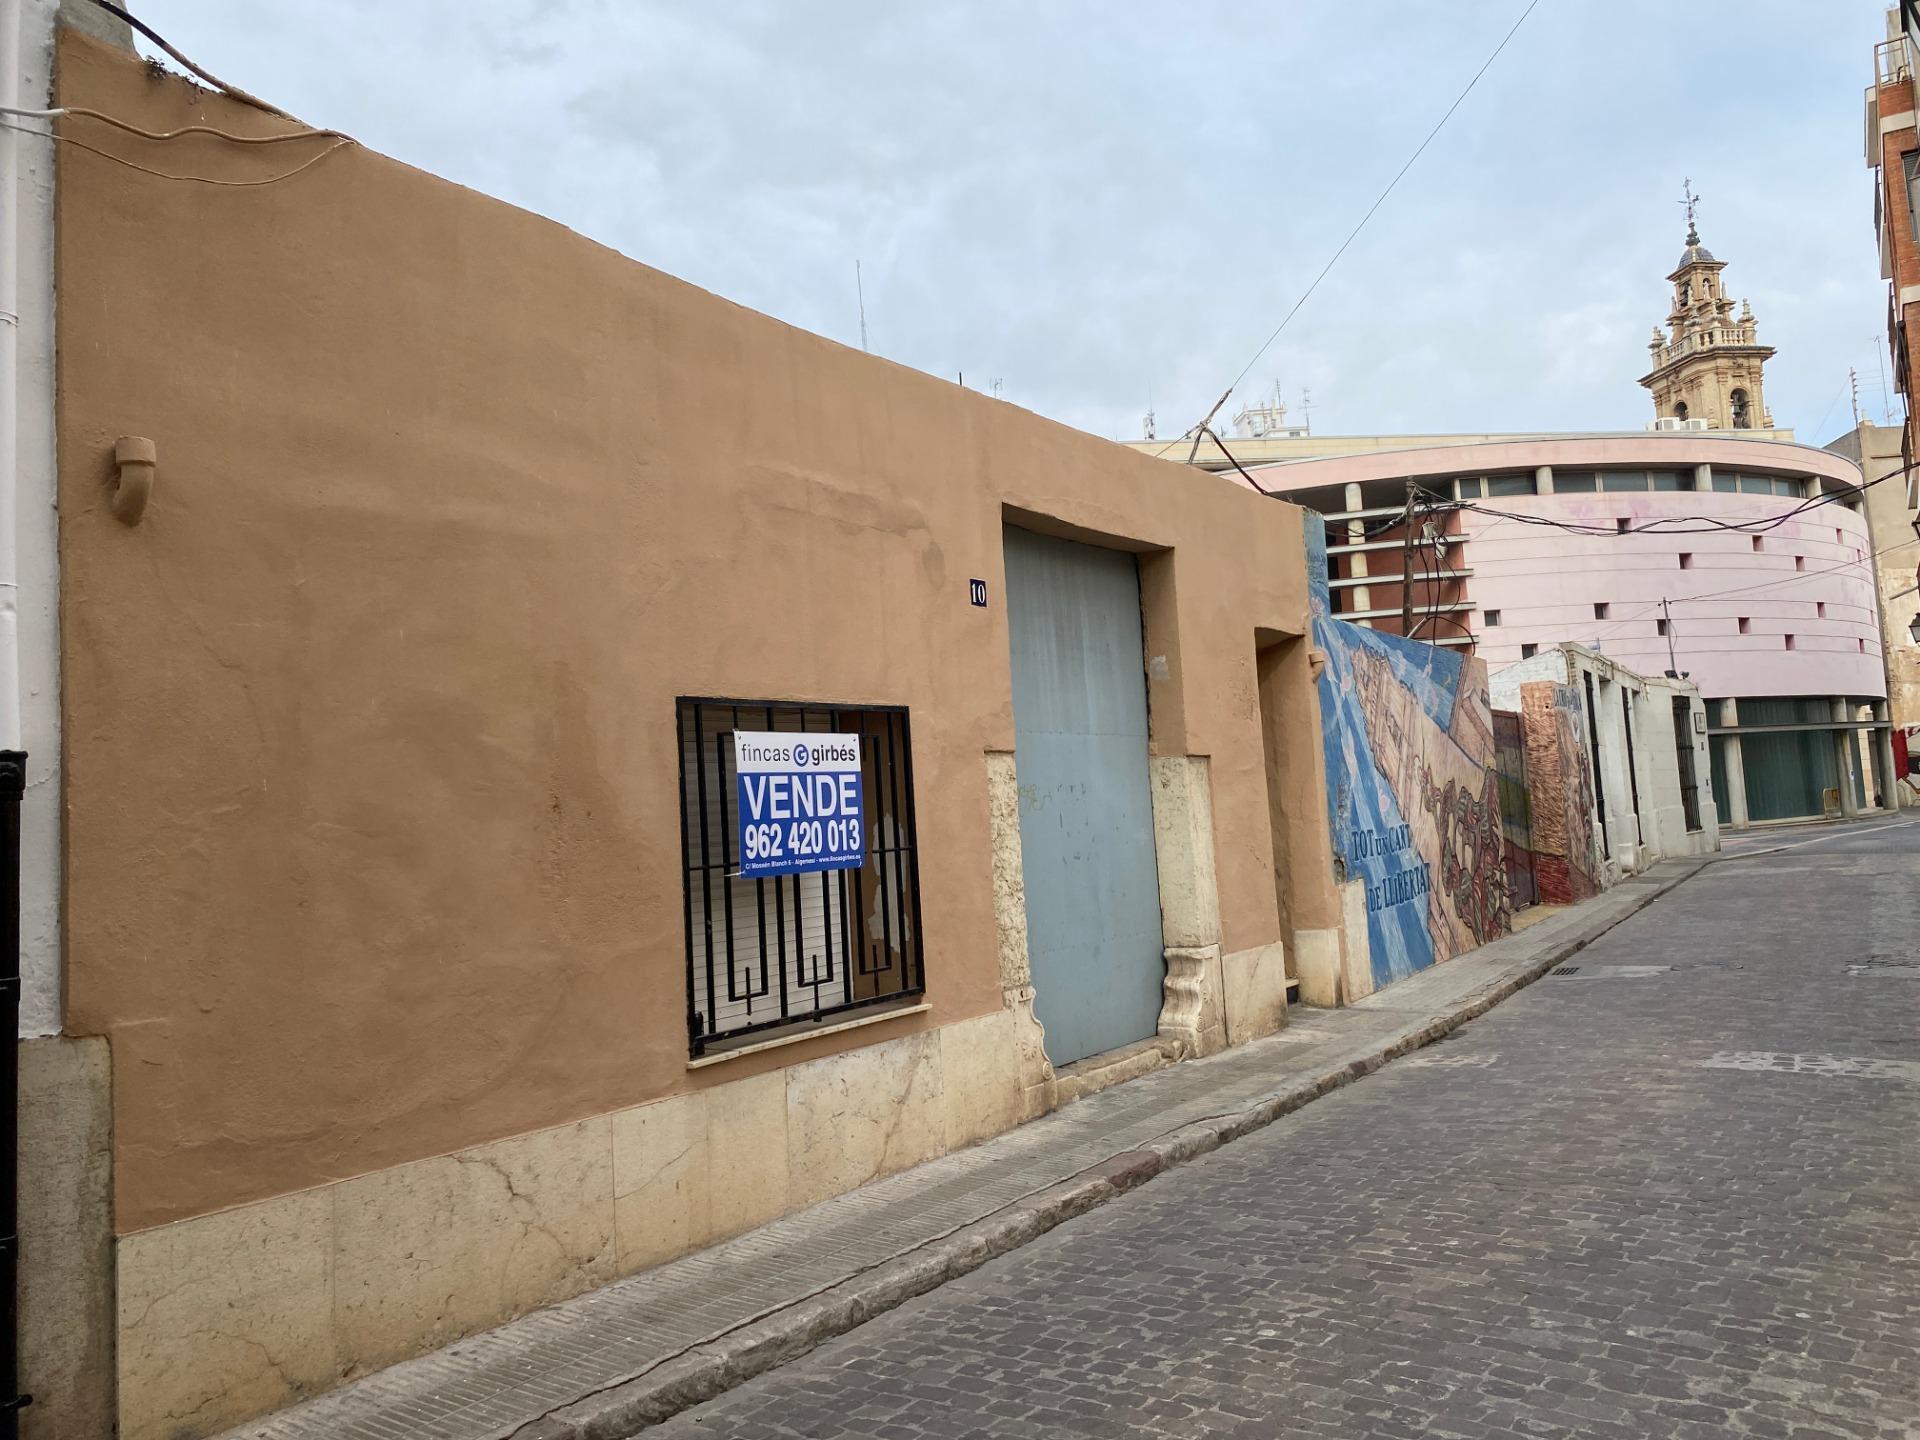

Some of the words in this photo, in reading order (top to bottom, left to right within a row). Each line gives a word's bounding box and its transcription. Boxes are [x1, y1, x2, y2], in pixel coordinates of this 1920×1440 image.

[971, 583, 986, 604] 10
[741, 743, 791, 762] fincas
[812, 744, 856, 766] girbés
[744, 774, 859, 820] VENDE
[745, 823, 783, 860] 962
[787, 820, 823, 855] 420
[828, 818, 861, 852] 013
[1352, 829, 1373, 861] TOT
[1375, 837, 1388, 855] UN
[1388, 824, 1411, 853] CANT
[1368, 887, 1383, 912] DE
